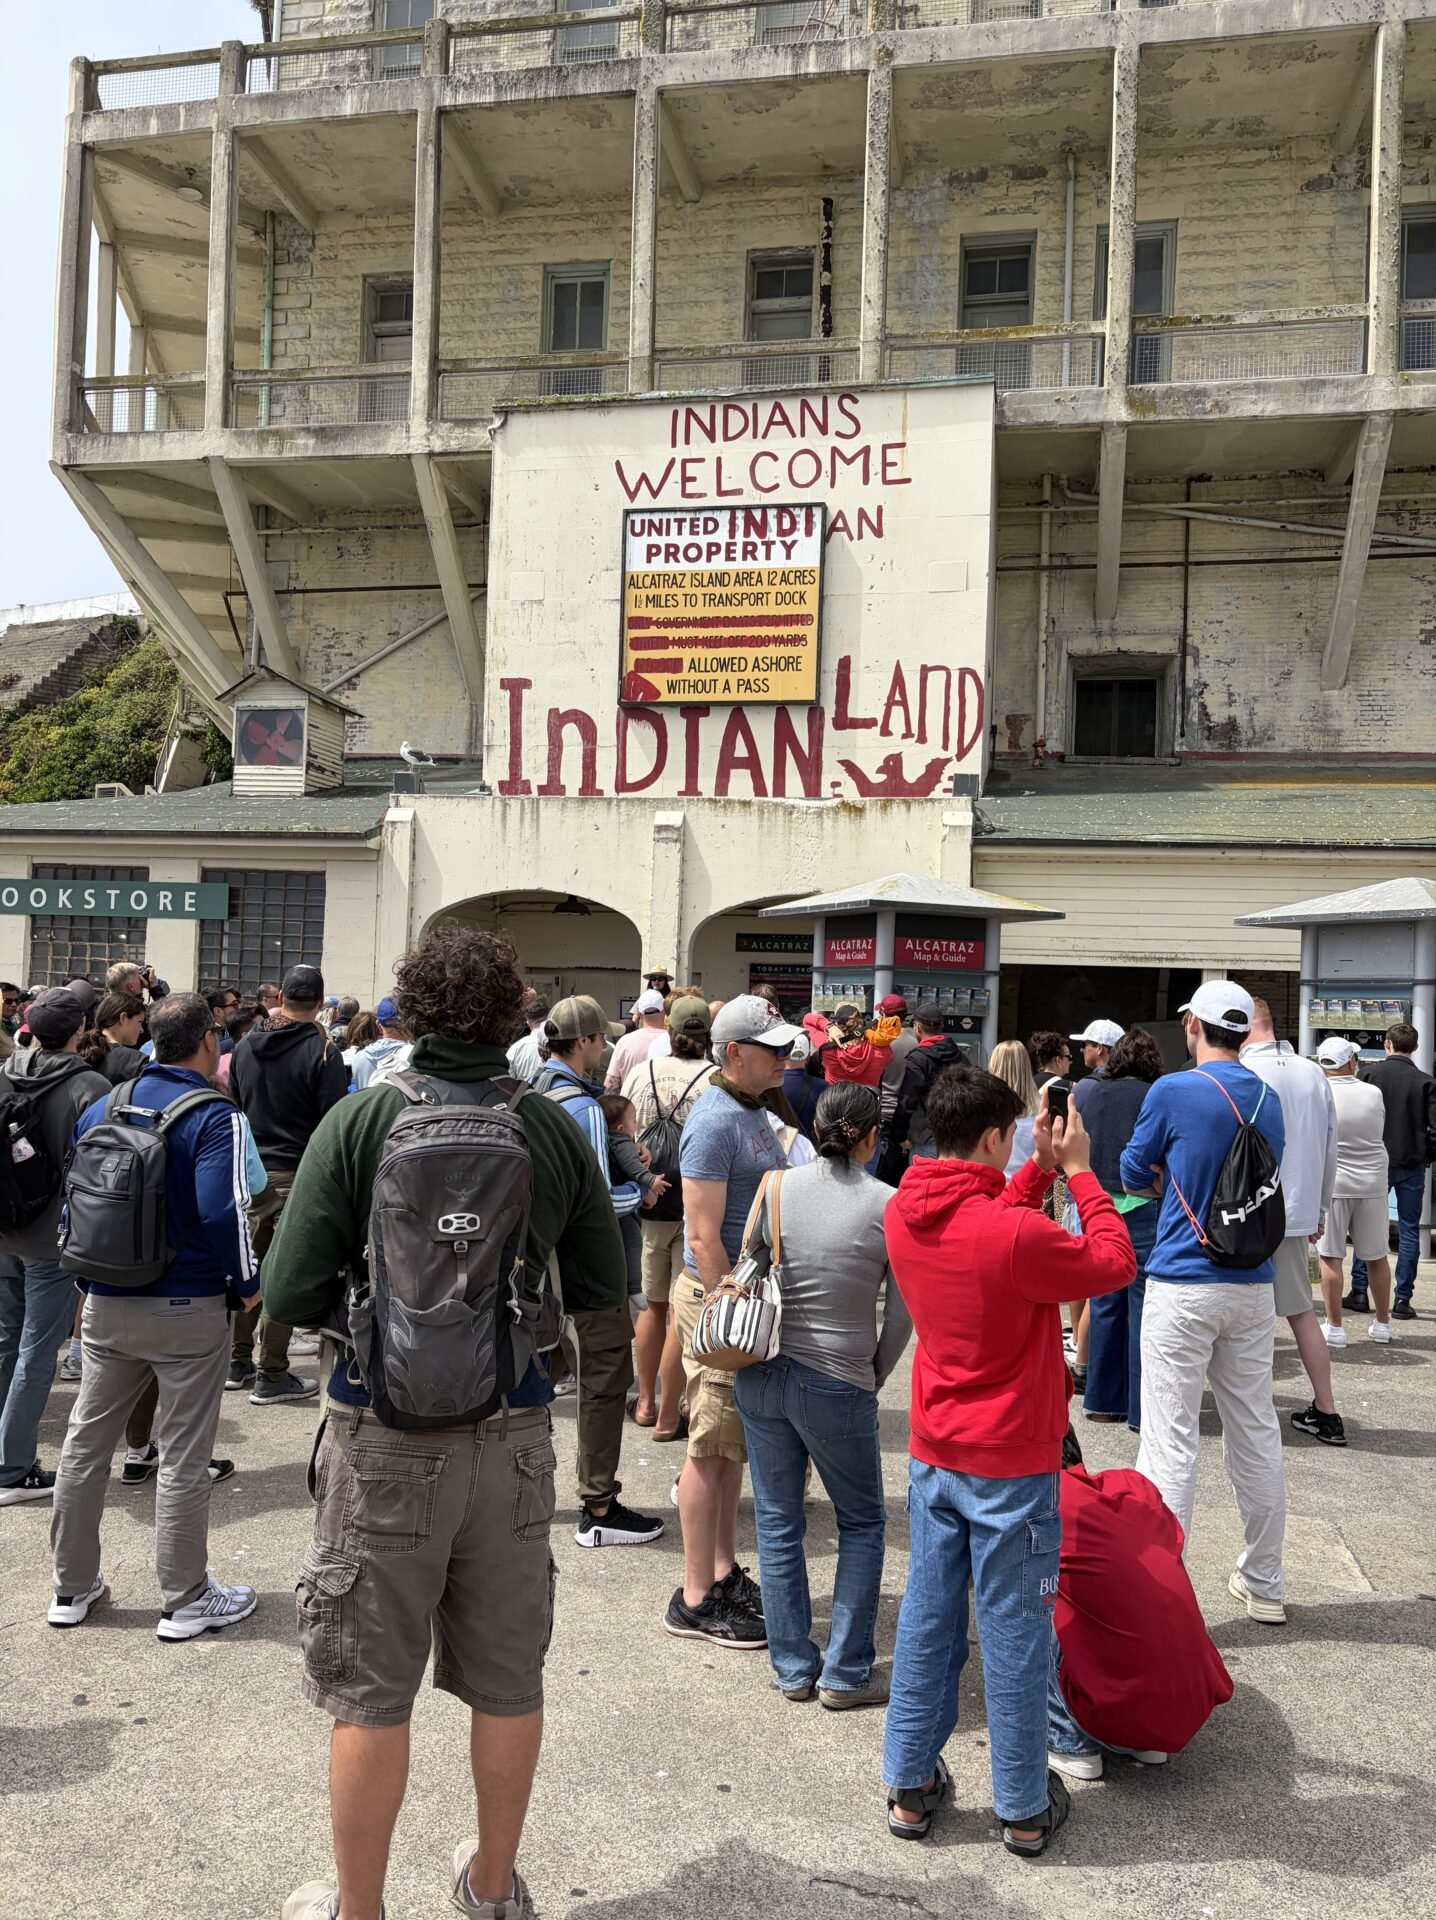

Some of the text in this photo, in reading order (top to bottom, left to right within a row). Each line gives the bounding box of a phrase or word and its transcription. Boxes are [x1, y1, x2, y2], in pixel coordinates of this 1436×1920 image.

[670, 393, 861, 448] INDIANS
[615, 442, 912, 502] WELCOME
[629, 516, 720, 538] UNITED
[646, 540, 798, 564] PROPERTY
[628, 569, 816, 589] ALCATRAZ ISLAND AREA 12 ACRES
[645, 593, 679, 609] MILES
[682, 592, 698, 608] TO
[702, 591, 772, 607] TRANSPORT
[775, 590, 807, 606] DOCK
[771, 633, 808, 648] YARDS
[688, 656, 748, 673] ALLOWED
[751, 655, 803, 672] ASHORE
[667, 678, 770, 694] WITHOUT A PASS
[751, 941, 809, 950] ALCATRAZ
[830, 939, 873, 950] ALCATRAZ
[905, 939, 975, 953] ALCATRAZ
[835, 952, 847, 962] Map
[851, 951, 867, 961] Guide
[913, 952, 932, 963] Map
[942, 954, 966, 963] Guide
